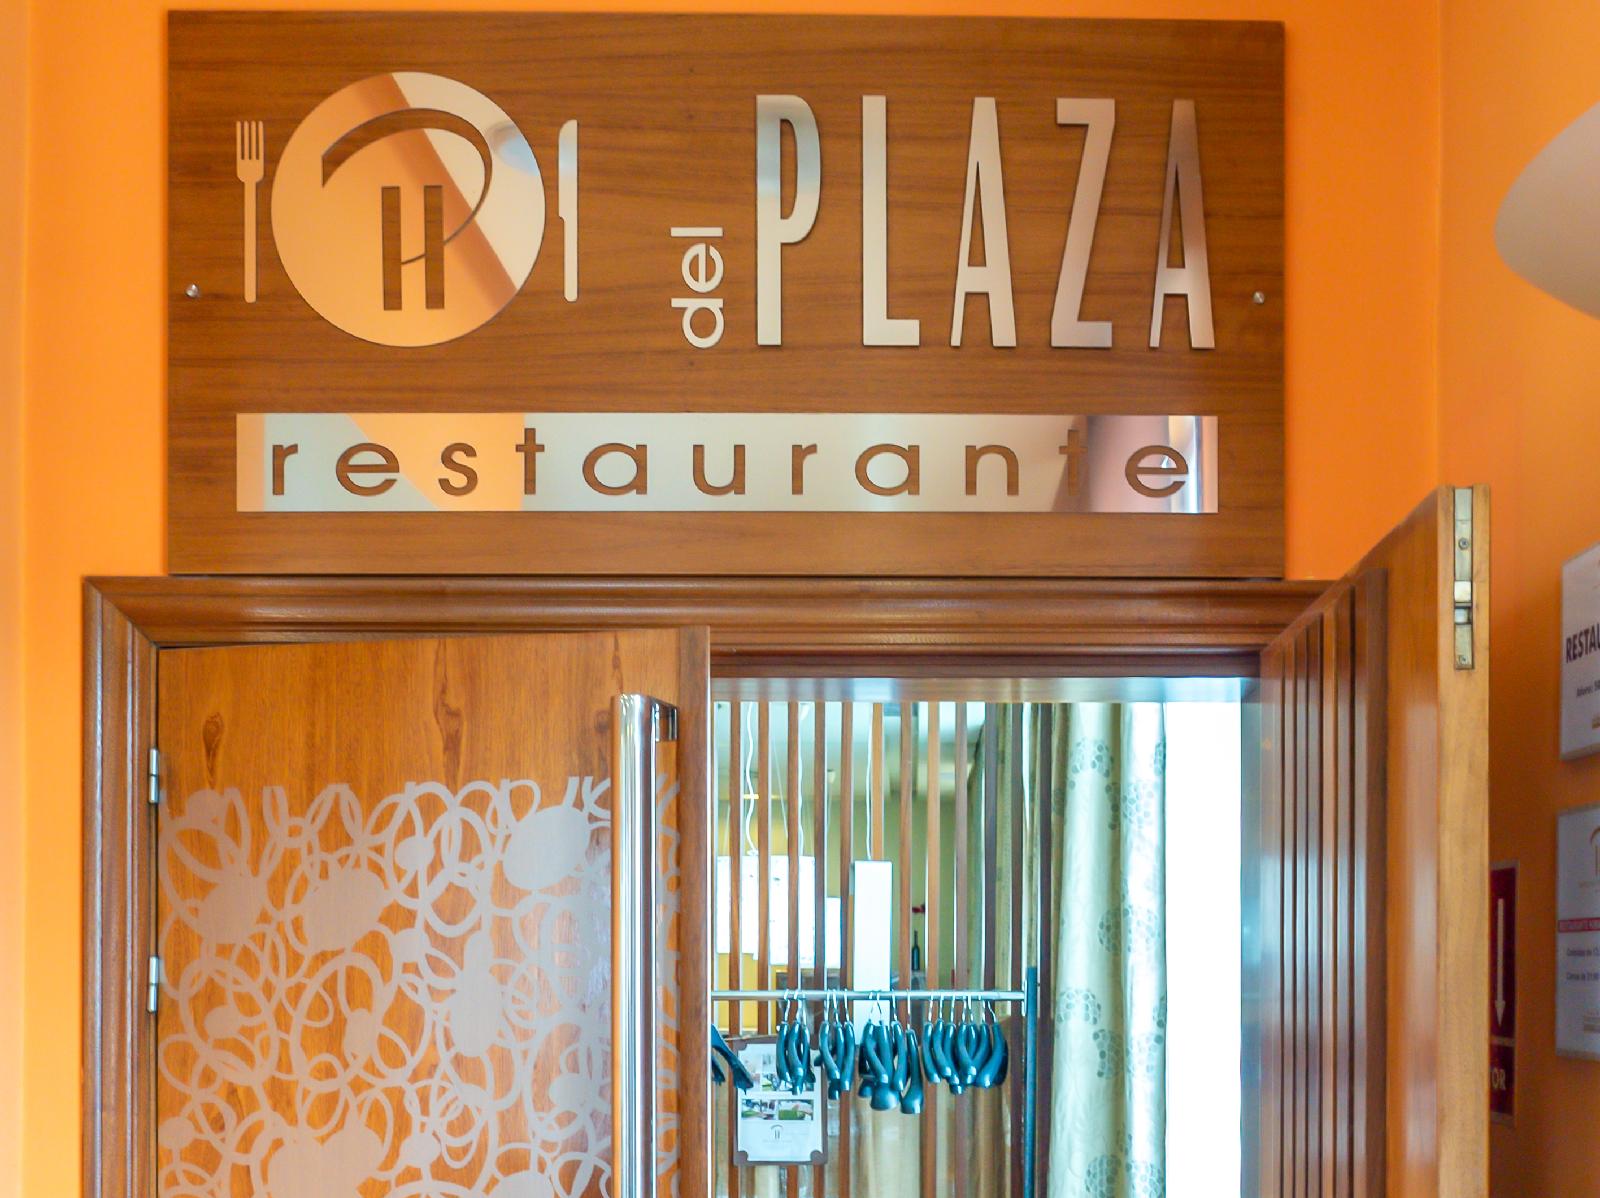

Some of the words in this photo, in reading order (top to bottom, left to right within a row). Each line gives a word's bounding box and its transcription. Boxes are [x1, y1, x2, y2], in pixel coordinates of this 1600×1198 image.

[670, 226, 725, 349] del
[755, 94, 1215, 349] PLAZA
[271, 427, 1189, 498] restaurante
